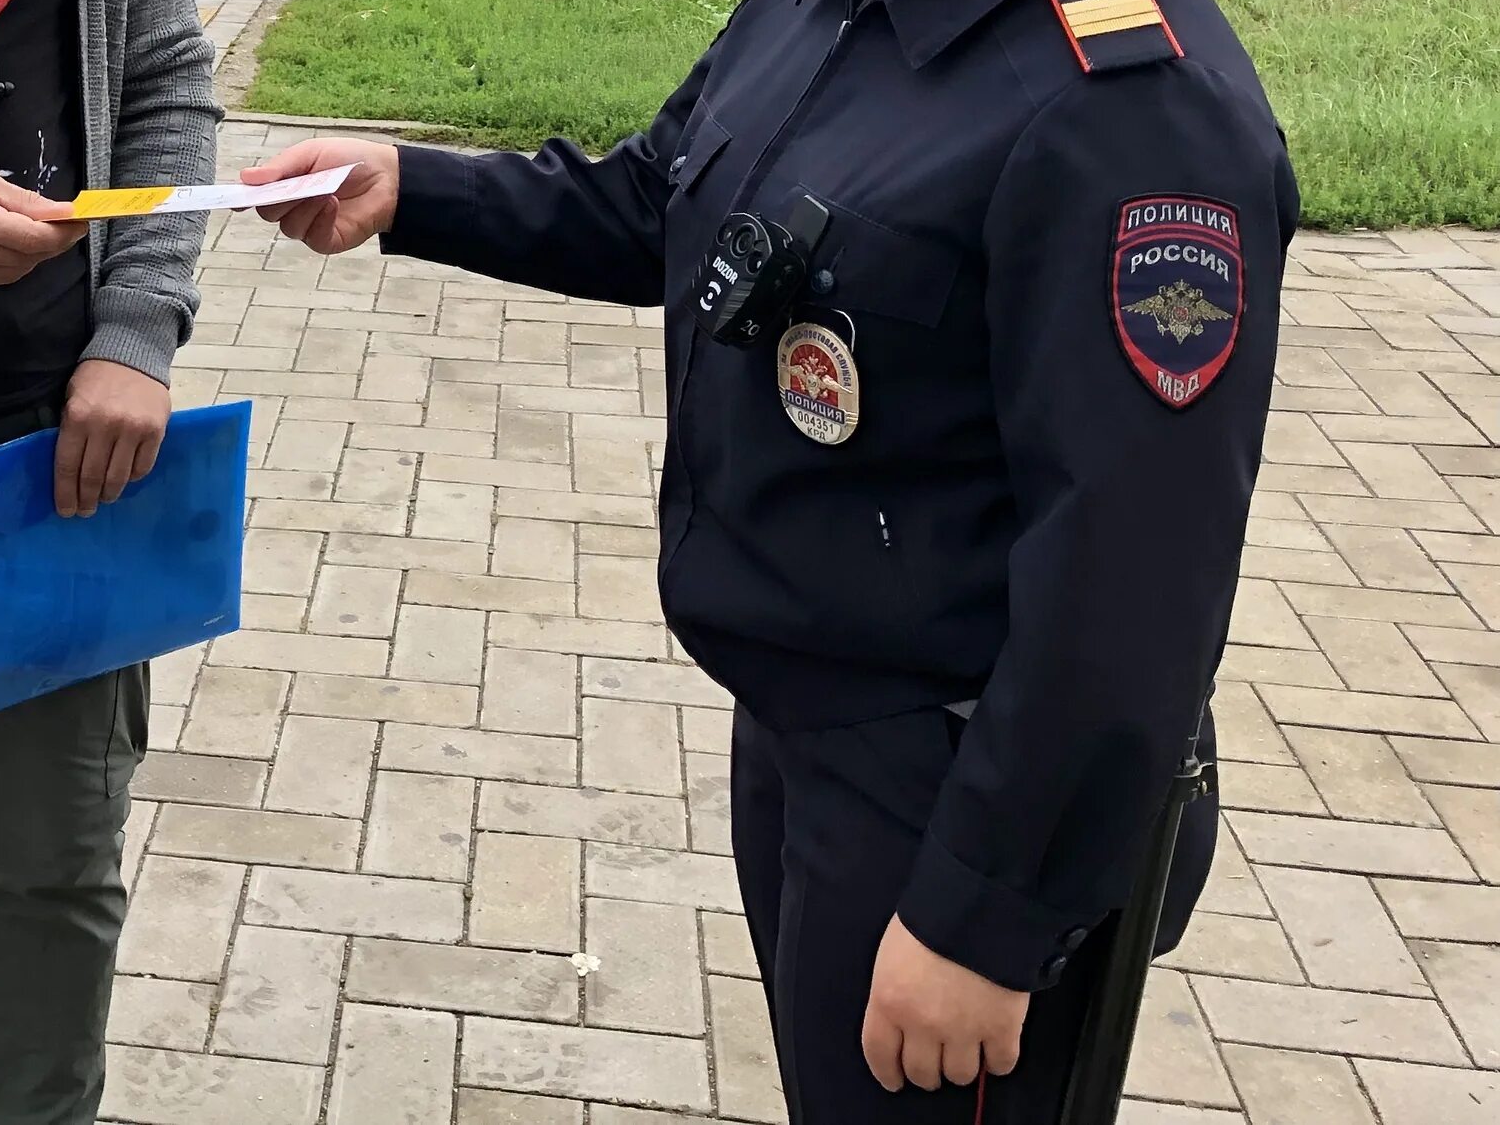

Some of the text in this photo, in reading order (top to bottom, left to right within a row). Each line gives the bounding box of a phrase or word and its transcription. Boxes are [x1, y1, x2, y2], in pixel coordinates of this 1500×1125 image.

[1127, 204, 1233, 236] ПОЛИЦИЯ
[712, 256, 738, 285] DOZOR
[1130, 244, 1230, 283] РОССИЯ
[740, 319, 760, 336] 20
[1156, 370, 1200, 402] МВД
[787, 393, 843, 423] ПОЛИЦИЯ
[797, 411, 834, 434] 004351
[807, 427, 826, 441] КРД
